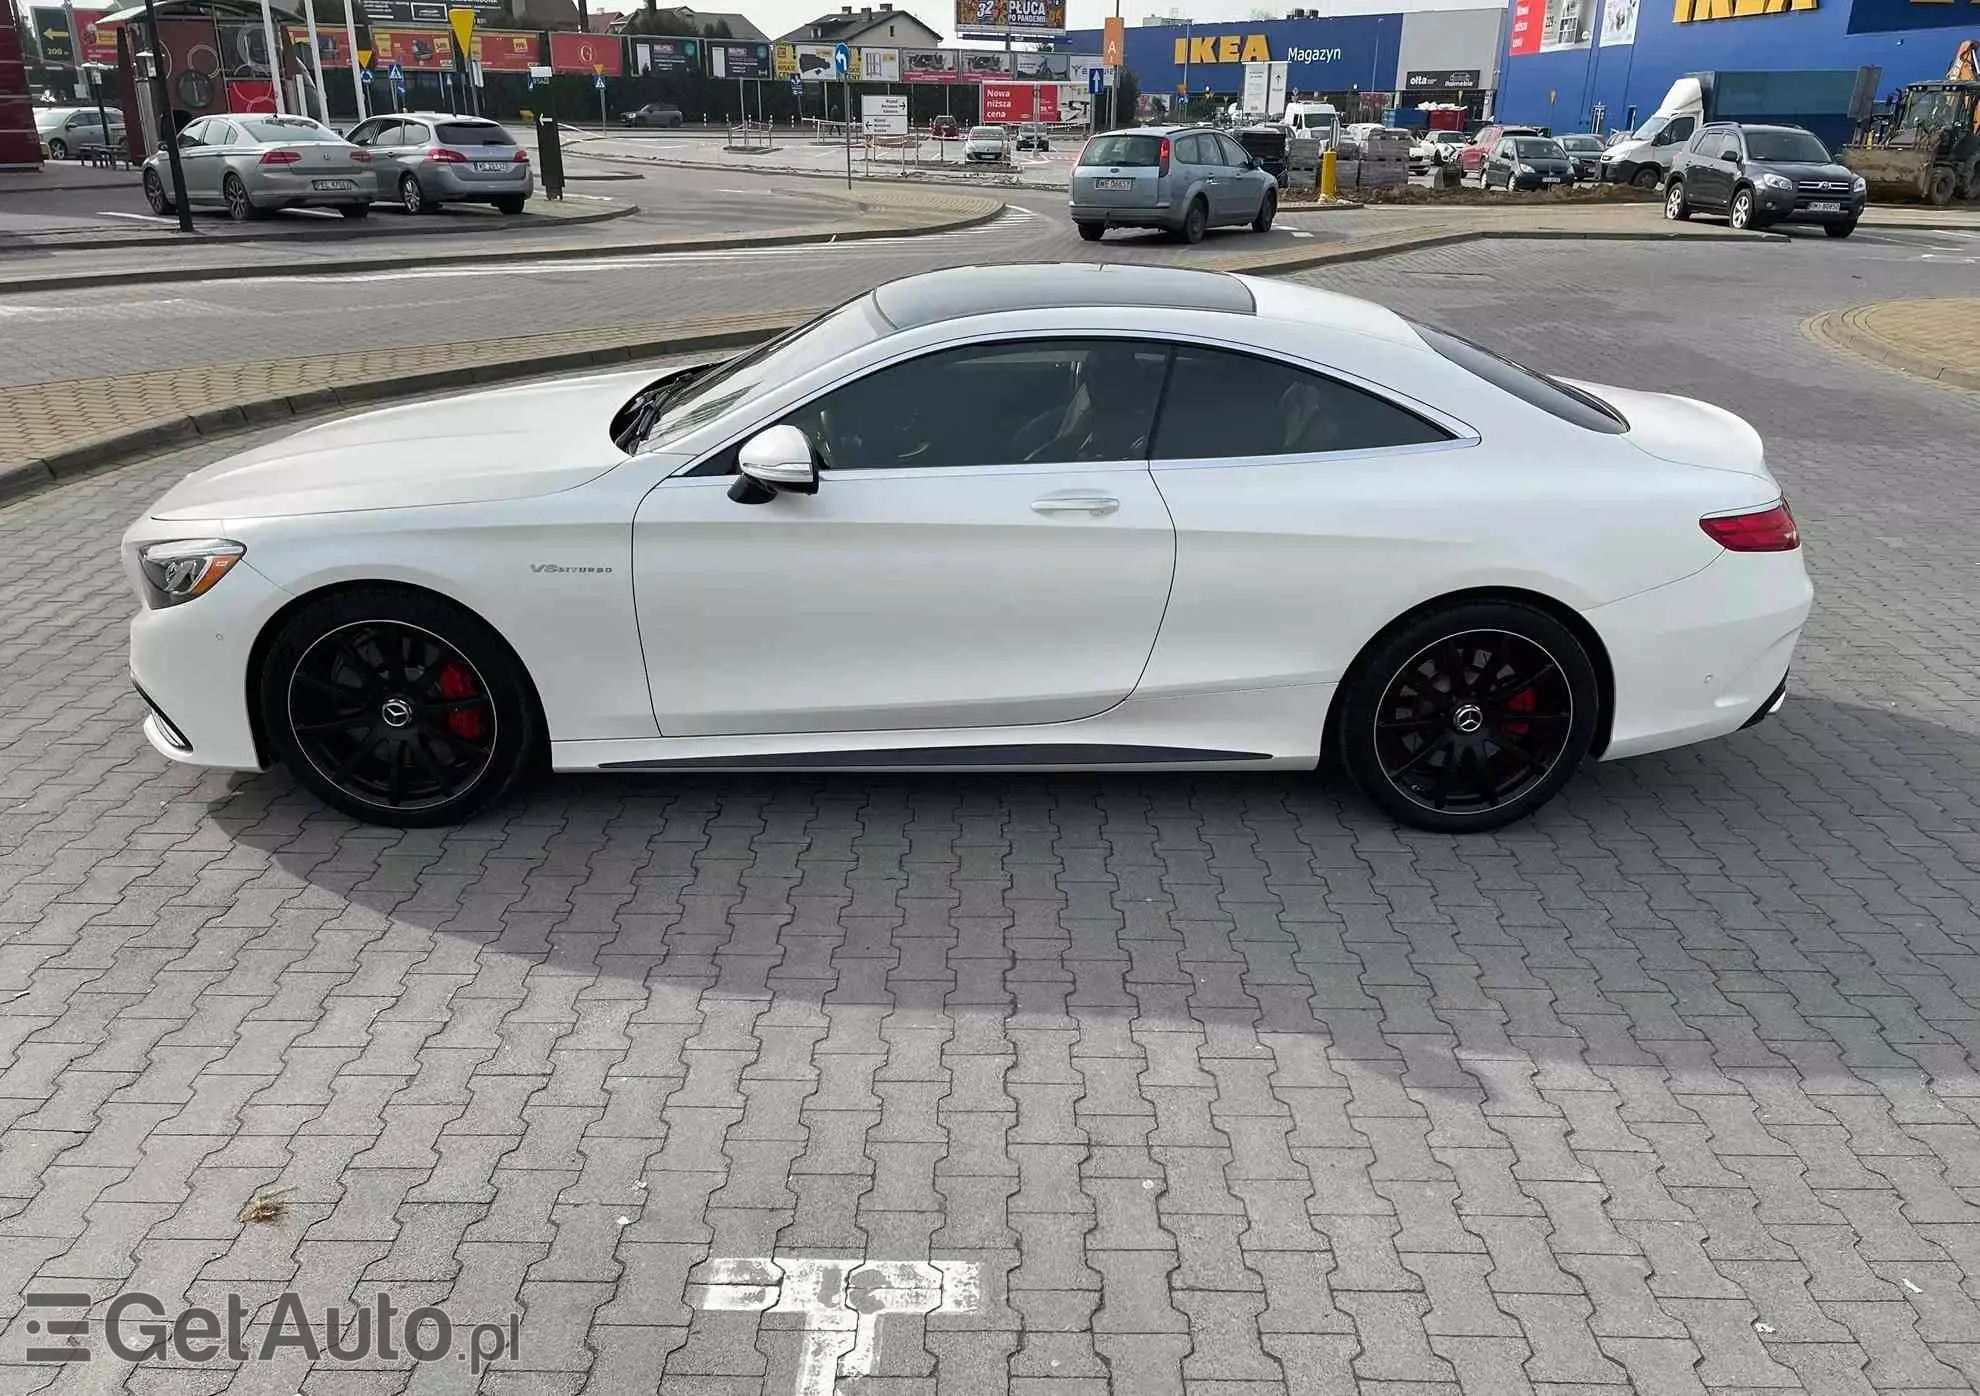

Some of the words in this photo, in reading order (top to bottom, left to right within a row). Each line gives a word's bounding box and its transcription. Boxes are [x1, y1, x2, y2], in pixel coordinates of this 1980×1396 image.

[1174, 34, 1271, 64] IKEA
[1287, 47, 1341, 64] Magazyn
[987, 89, 1010, 97] Nowa
[987, 99, 1011, 108] niższa
[987, 110, 1006, 118] cena
